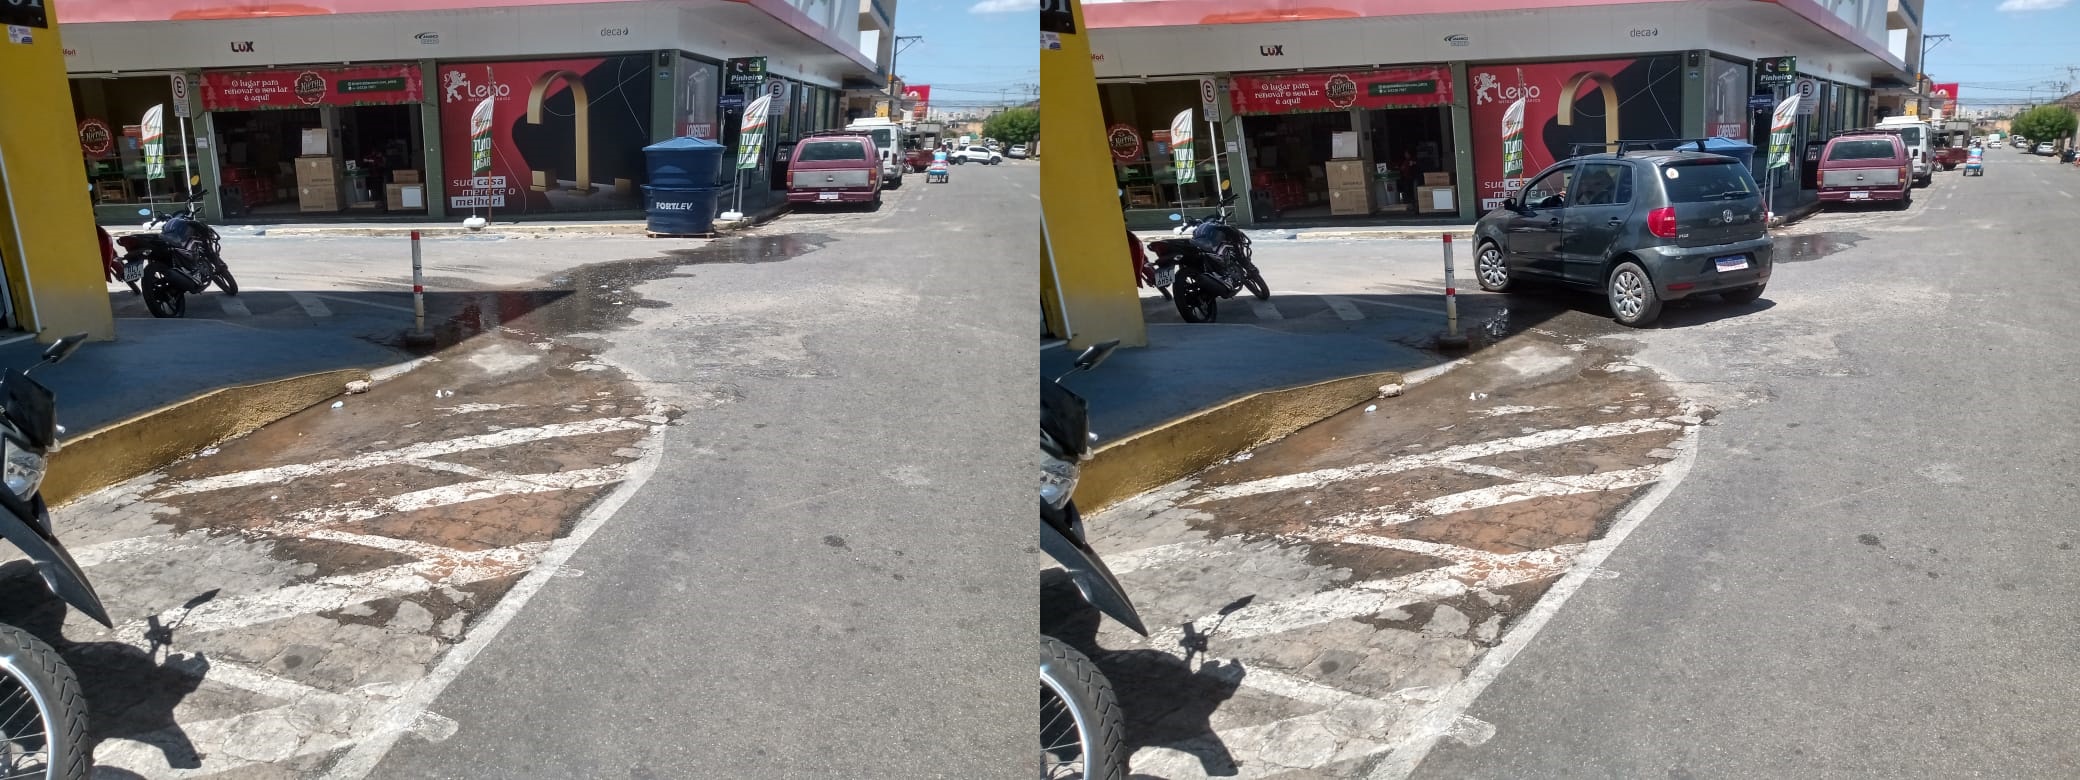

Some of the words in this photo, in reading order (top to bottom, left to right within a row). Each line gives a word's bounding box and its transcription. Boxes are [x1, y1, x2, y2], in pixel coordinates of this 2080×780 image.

[601, 27, 622, 36] deca
[1630, 28, 1651, 37] deca
[240, 79, 260, 88] lugar
[1270, 83, 1290, 92] lugar
[1292, 83, 1309, 91] para
[1254, 91, 1283, 99] renovar
[477, 177, 504, 186] casa
[1484, 181, 1504, 189] sua
[508, 187, 516, 195] o
[455, 197, 501, 207] melhor!
[656, 201, 693, 210] FORTLEV
